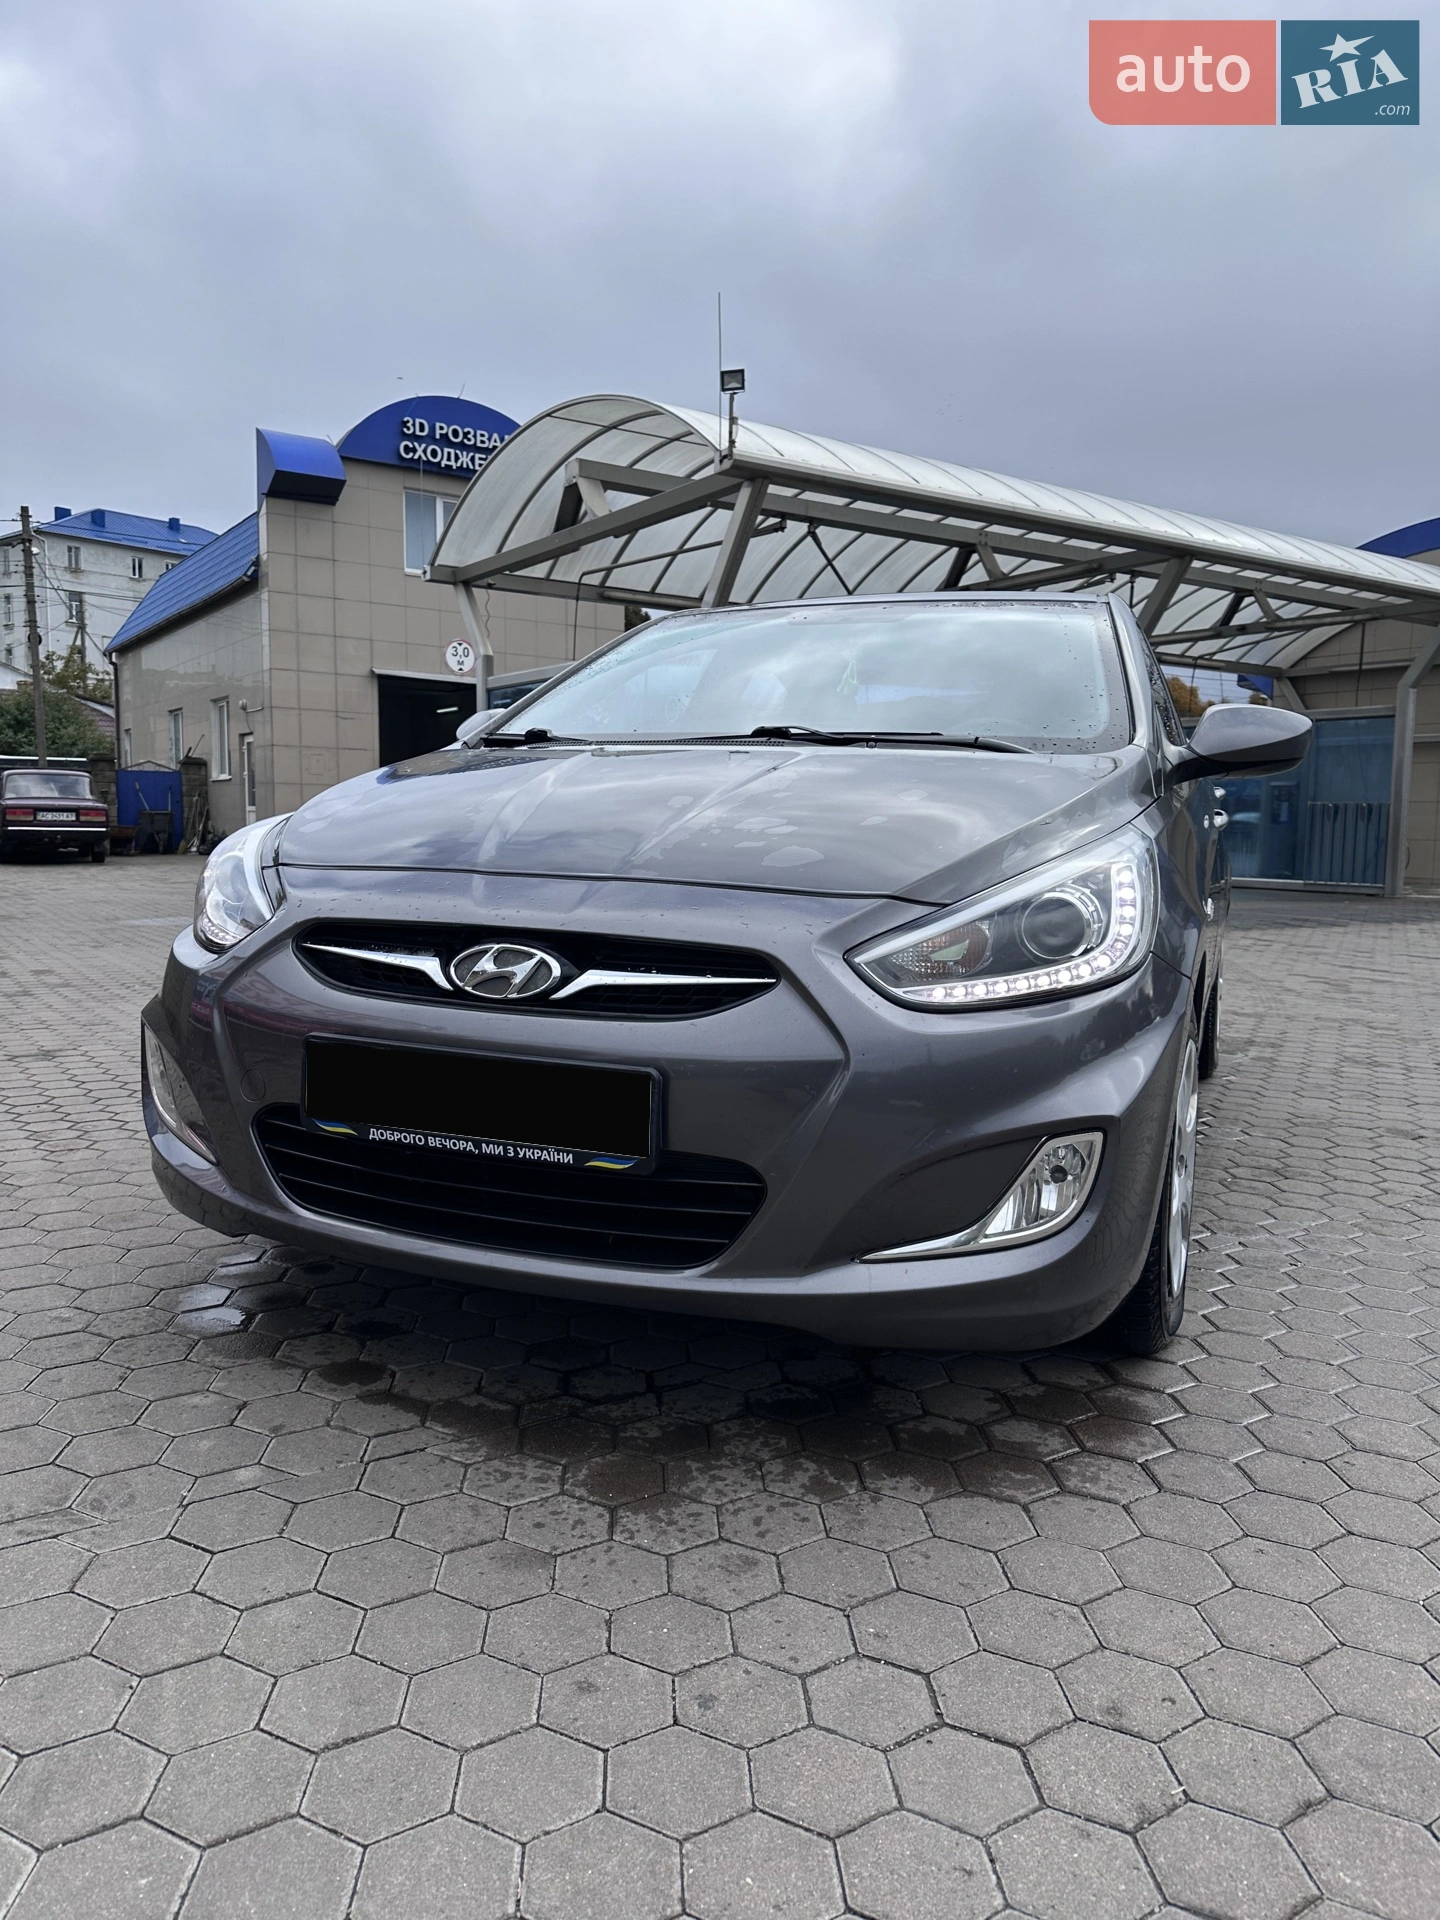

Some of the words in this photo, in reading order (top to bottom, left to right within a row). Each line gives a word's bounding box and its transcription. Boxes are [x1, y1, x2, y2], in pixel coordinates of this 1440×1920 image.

[402, 416, 430, 437] 3D
[435, 422, 512, 449] РОЗВА
[399, 440, 492, 471] СХОДЖЕ
[451, 645, 470, 660] 3,0
[369, 1128, 425, 1146] ДОБРОГО
[427, 1136, 479, 1154] ВЕЧОРА,
[481, 1143, 504, 1156] МИ
[516, 1147, 574, 1165] УКРАЇНИ
